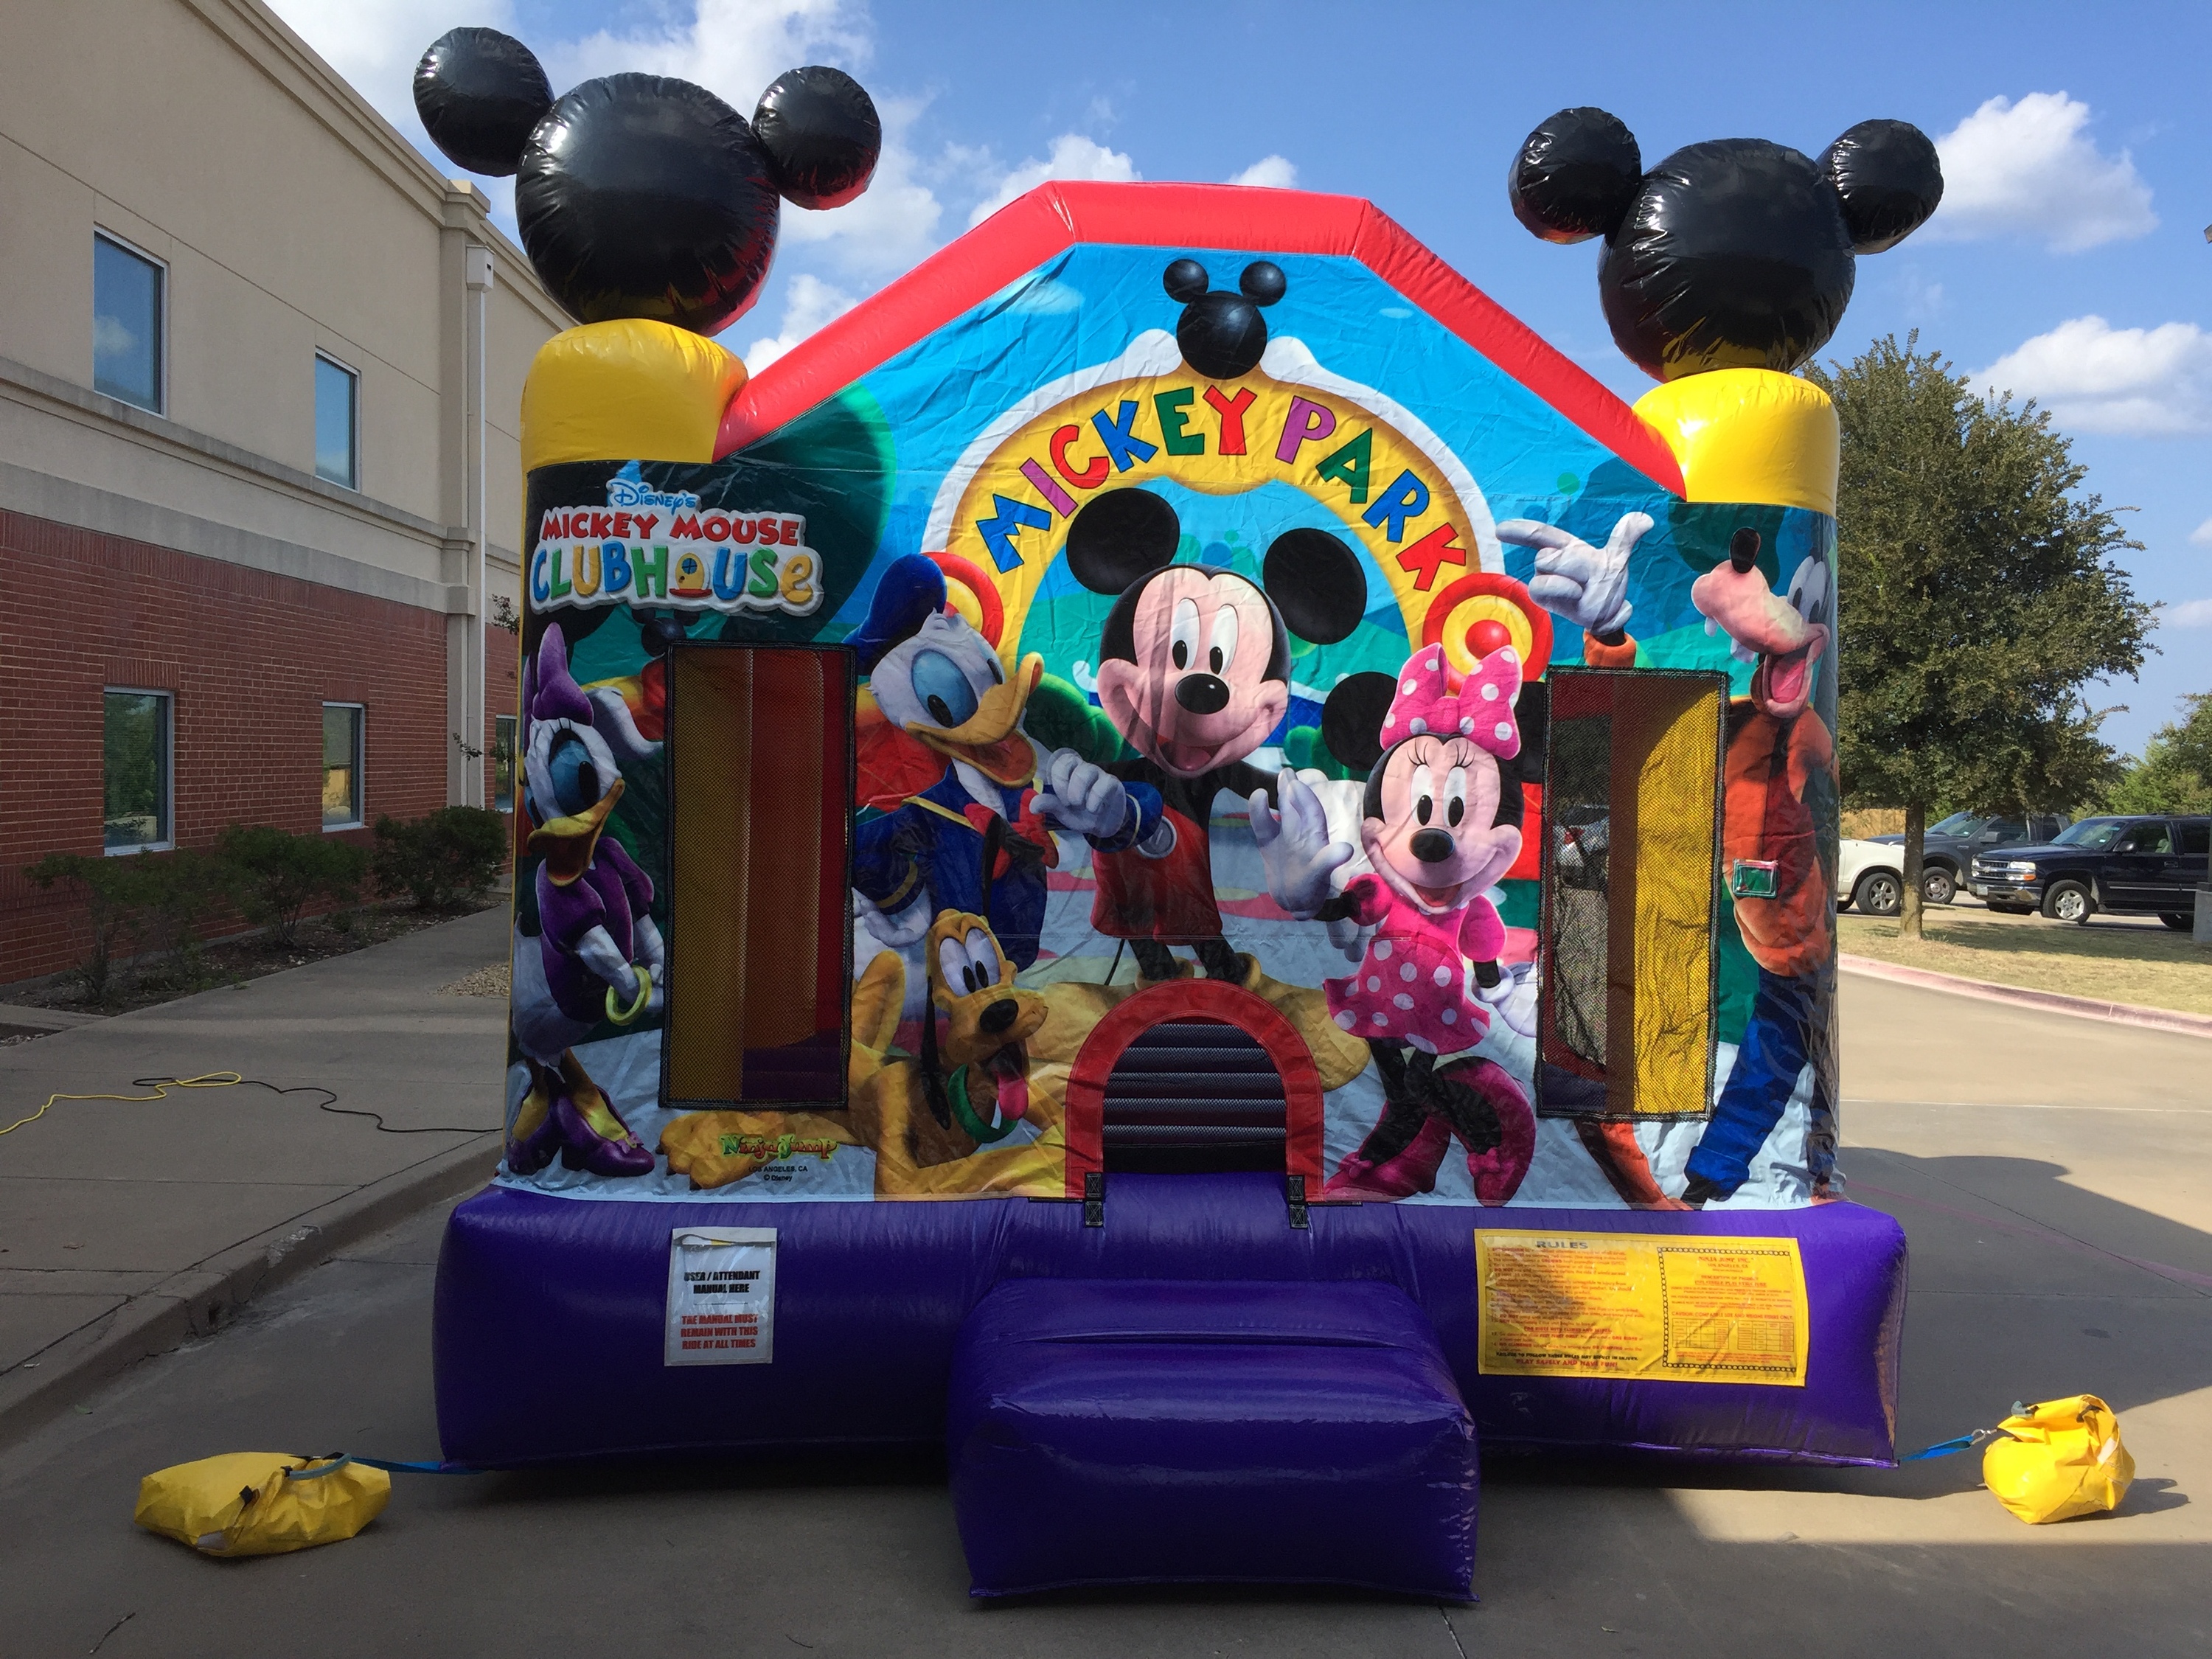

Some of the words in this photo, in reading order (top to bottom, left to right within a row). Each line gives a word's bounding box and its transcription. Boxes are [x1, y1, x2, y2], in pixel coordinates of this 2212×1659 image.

[975, 384, 1257, 574] MICKEY
[1275, 395, 1467, 591] PARK
[542, 512, 659, 540] MICKEY
[669, 513, 799, 546] MOUSE
[1536, 1240, 1588, 1249] RULES
[684, 1272, 705, 1281] USER
[712, 1270, 760, 1281] ATTENDANT
[693, 1284, 727, 1294] MANUAL
[728, 1283, 750, 1293] HERE
[682, 1315, 698, 1325] THE
[698, 1315, 733, 1324] MANUAL
[734, 1313, 759, 1324] MUST
[681, 1327, 713, 1338] REMAIN
[714, 1326, 737, 1337] WITH
[738, 1326, 759, 1336] THIS
[682, 1339, 701, 1350] RIDE
[703, 1339, 714, 1349] AT
[715, 1339, 729, 1349] ALL
[731, 1338, 756, 1349] TIMES
